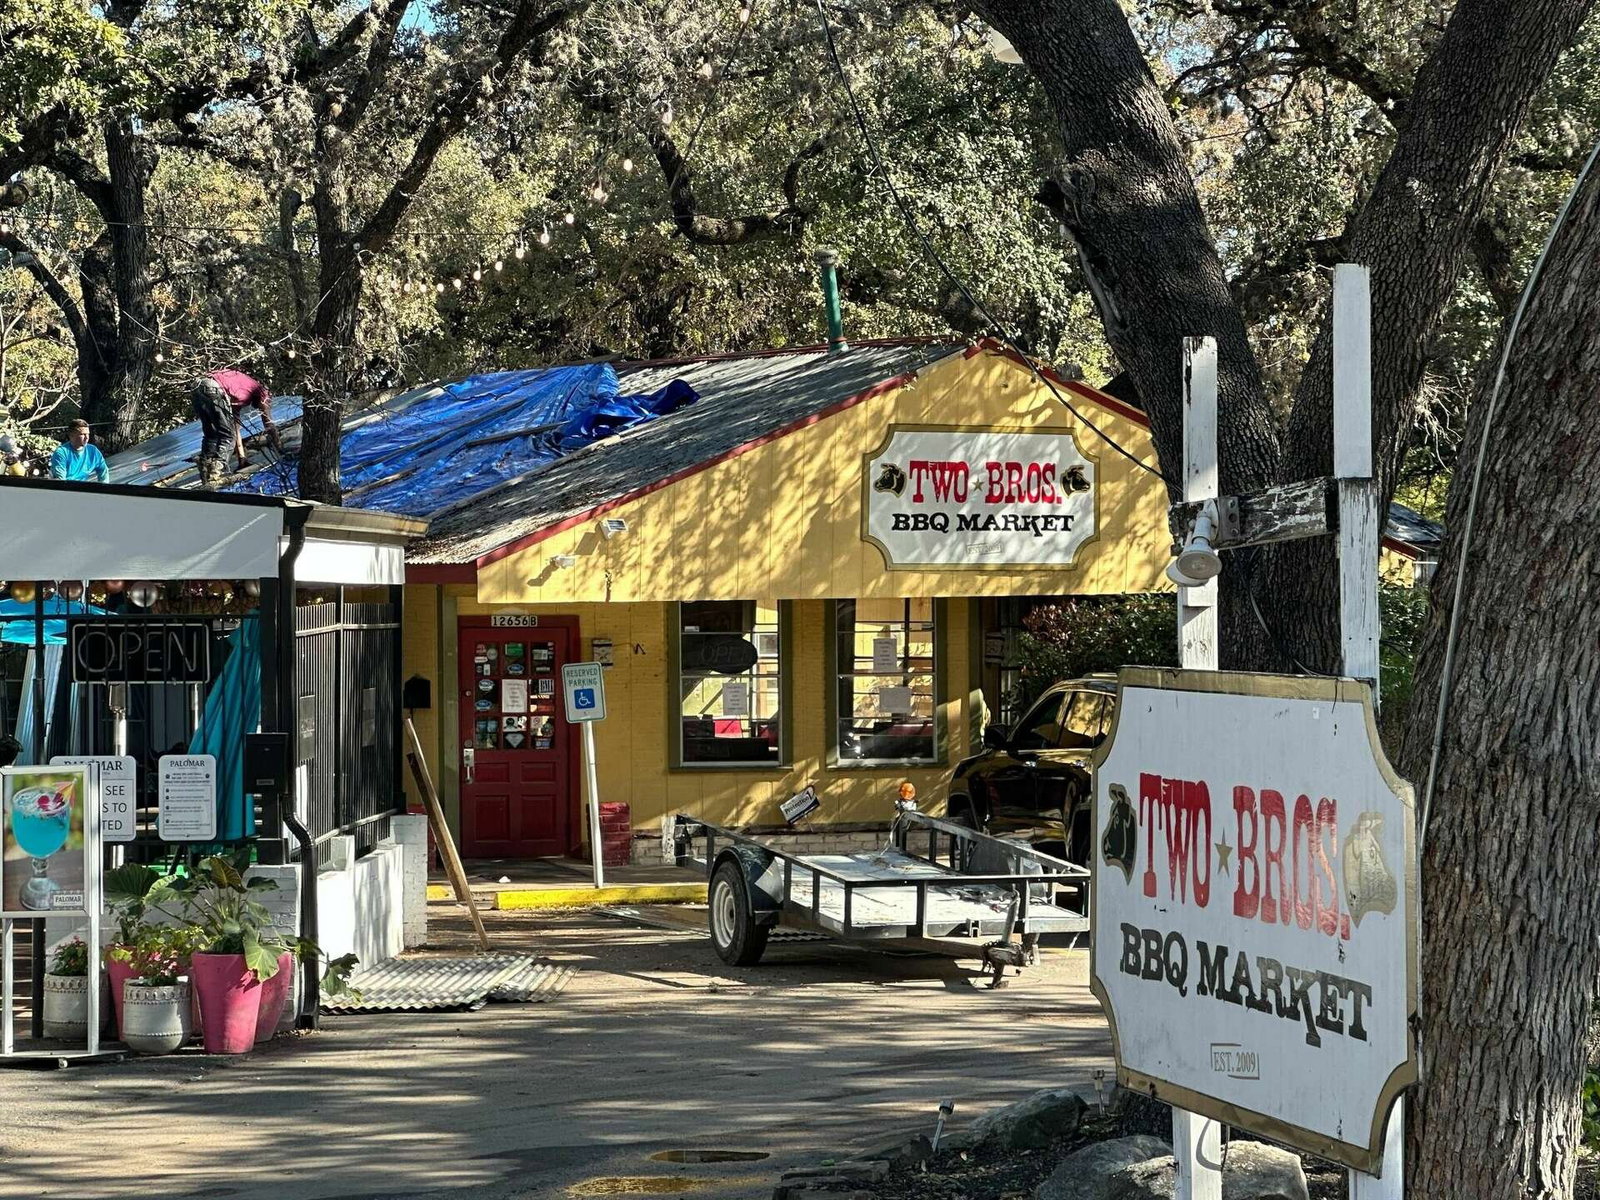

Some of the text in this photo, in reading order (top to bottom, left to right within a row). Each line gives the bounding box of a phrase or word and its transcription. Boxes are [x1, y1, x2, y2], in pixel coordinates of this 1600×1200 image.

[909, 460, 1063, 504] TWO BROS.
[891, 512, 1075, 537] BBQ MARKET
[77, 631, 197, 673] OPEN
[566, 669, 598, 677] RESERVED
[568, 678, 598, 687] PARKING
[105, 785, 126, 796] SEE
[111, 802, 128, 813] TO
[1139, 772, 1351, 941] TWO BROS.
[1119, 922, 1372, 1049] BBQ MARKET
[1213, 1051, 1256, 1073] EST. 2009
